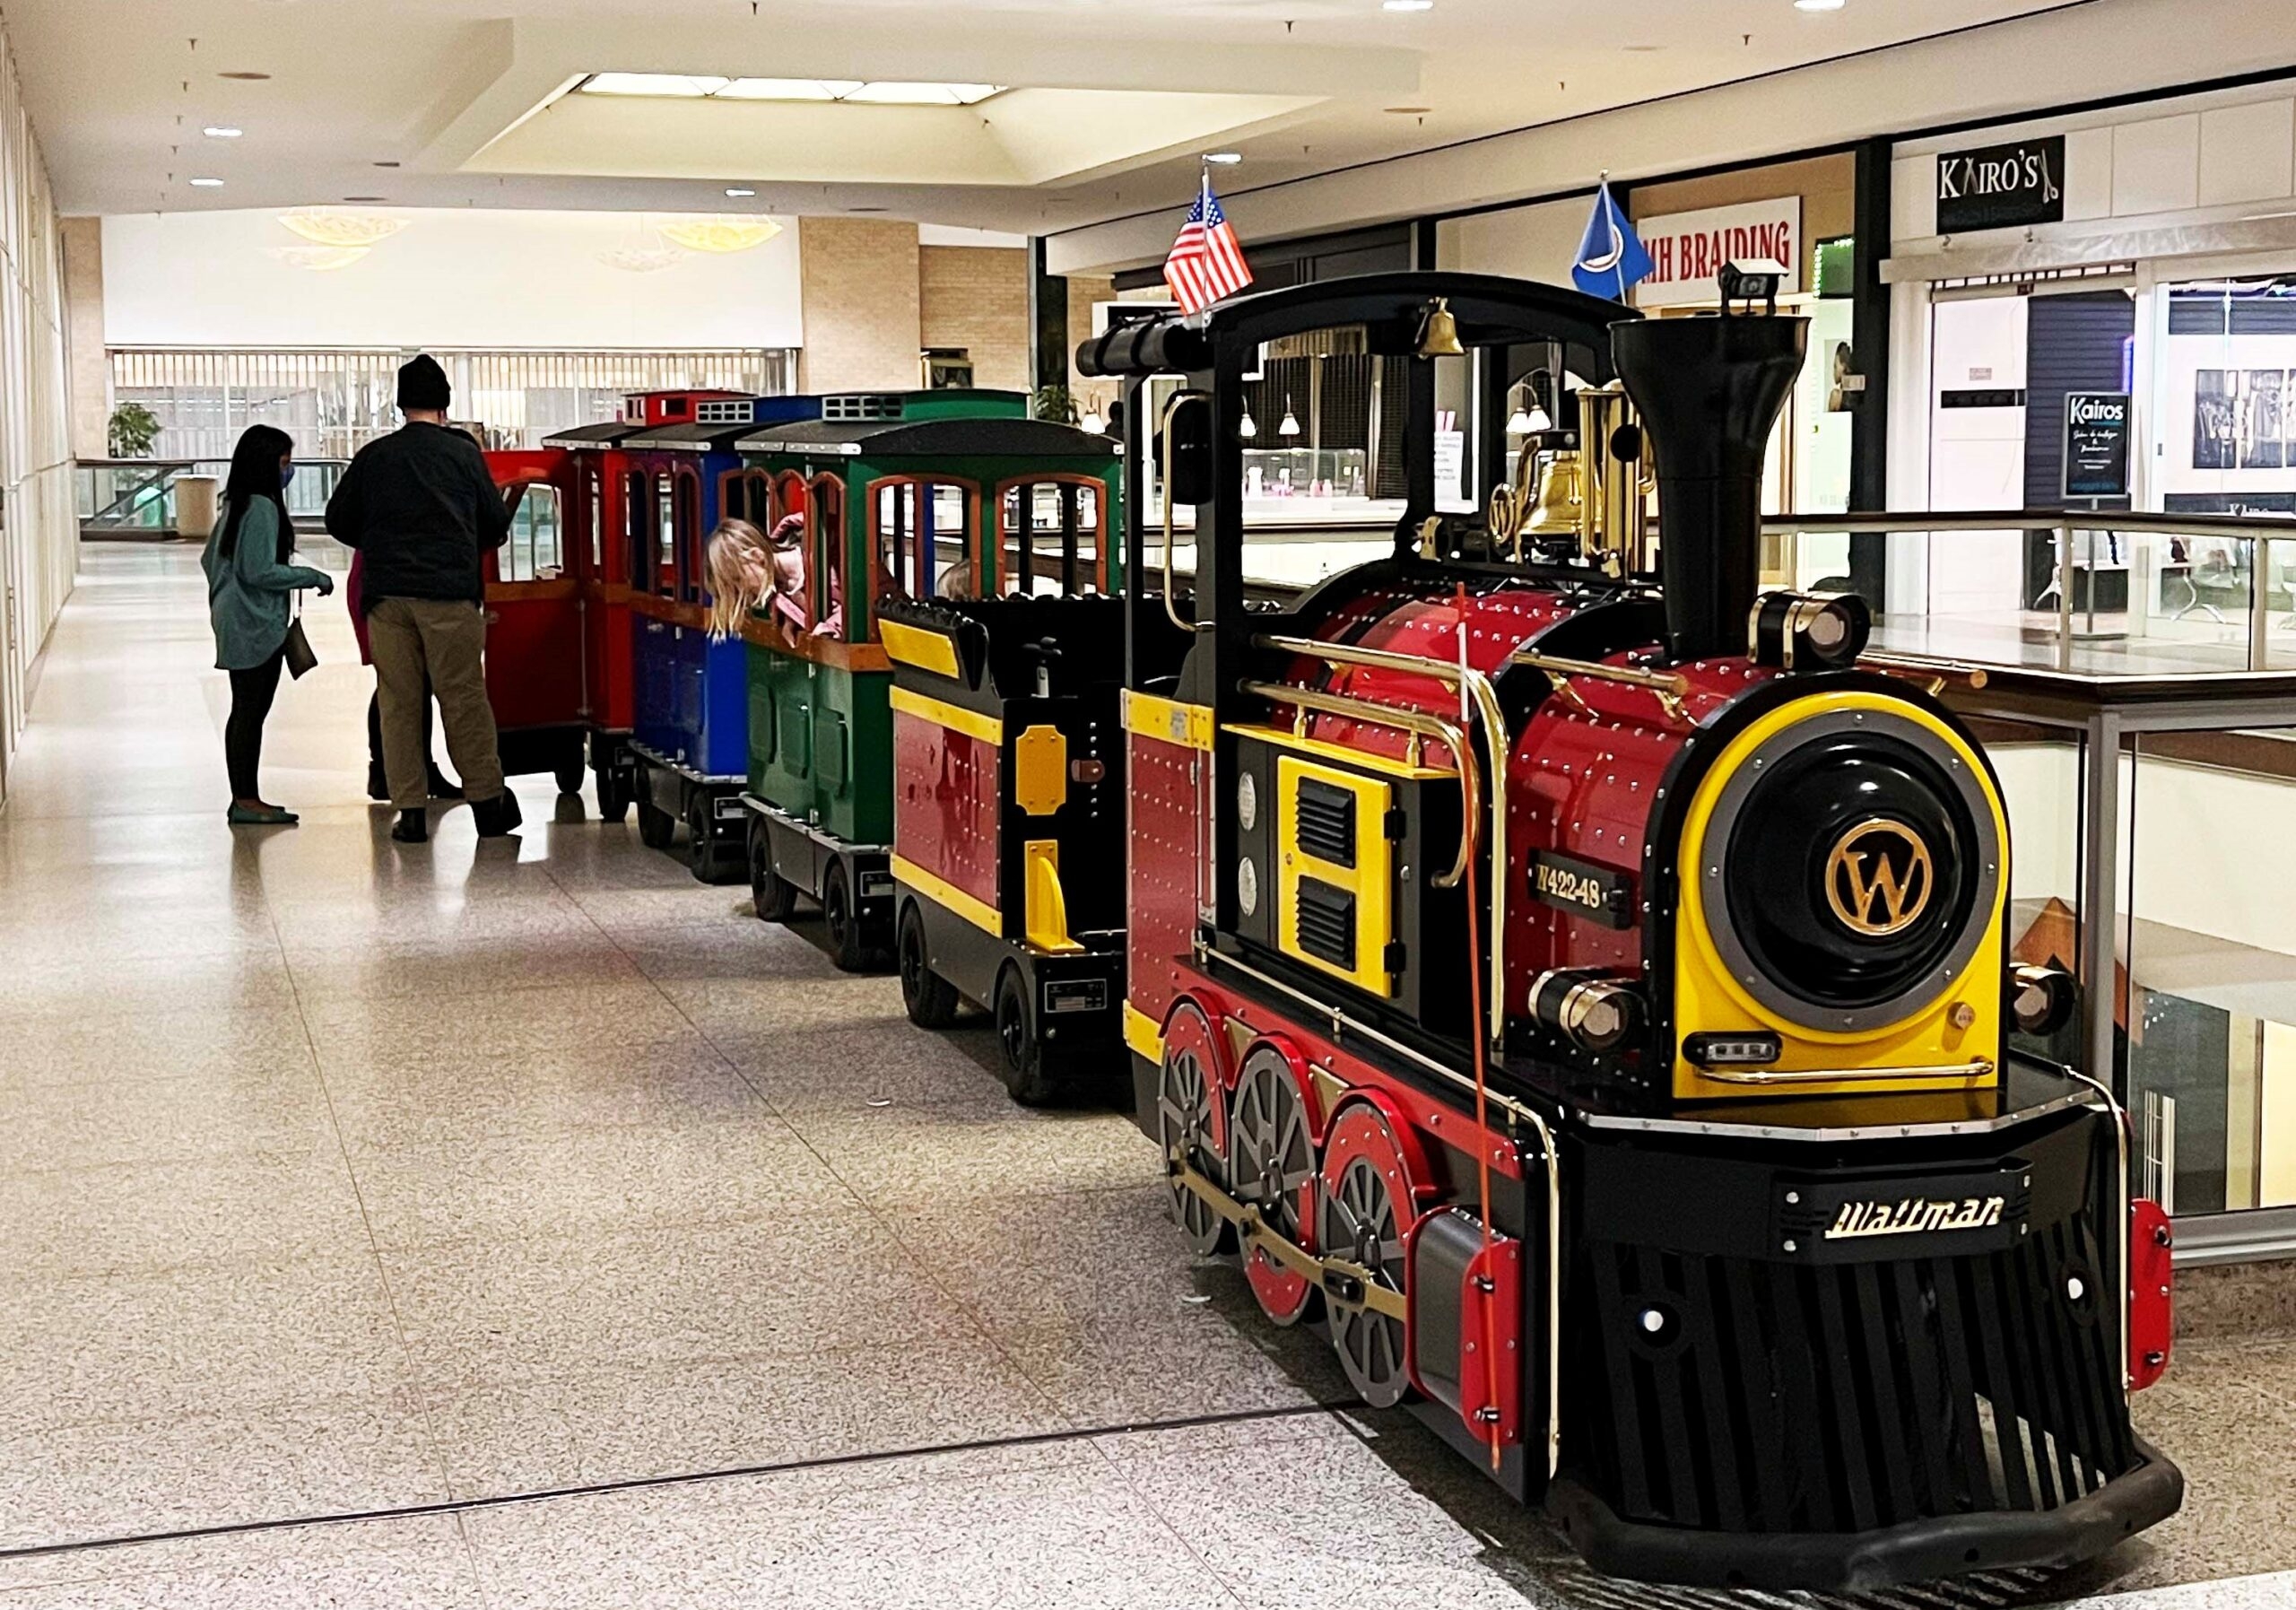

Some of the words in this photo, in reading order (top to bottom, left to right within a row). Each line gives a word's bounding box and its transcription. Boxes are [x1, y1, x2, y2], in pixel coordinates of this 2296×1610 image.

[1680, 221, 1790, 280] BRAIDING
[2070, 397, 2124, 424] Kairos
[1831, 840, 1926, 927] W
[1824, 1196, 2005, 1240] Wattman
